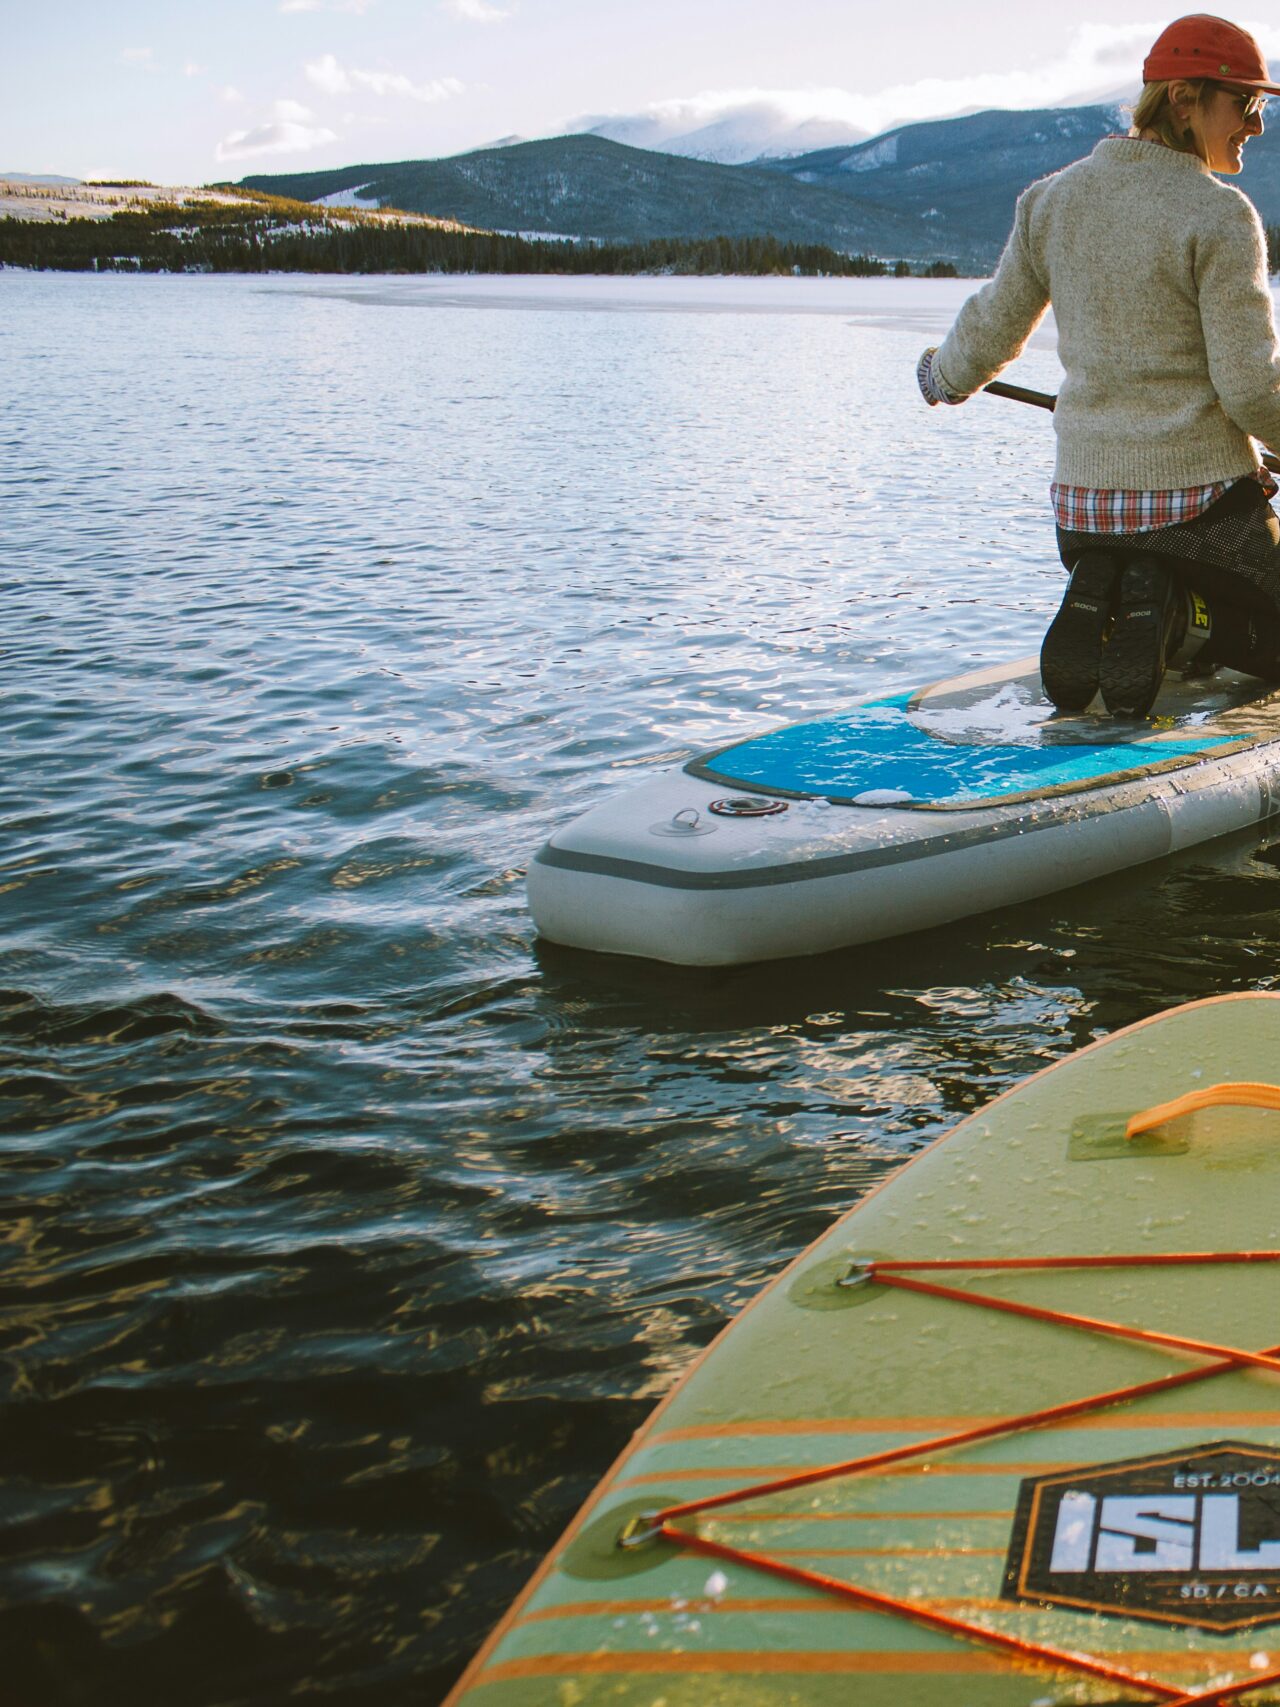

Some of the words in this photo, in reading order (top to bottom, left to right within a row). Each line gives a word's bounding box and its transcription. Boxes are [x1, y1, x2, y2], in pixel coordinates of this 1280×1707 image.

[1173, 1471, 1217, 1488] EST.
[1180, 1583, 1209, 1598] SD
[1233, 1583, 1267, 1597] CA
